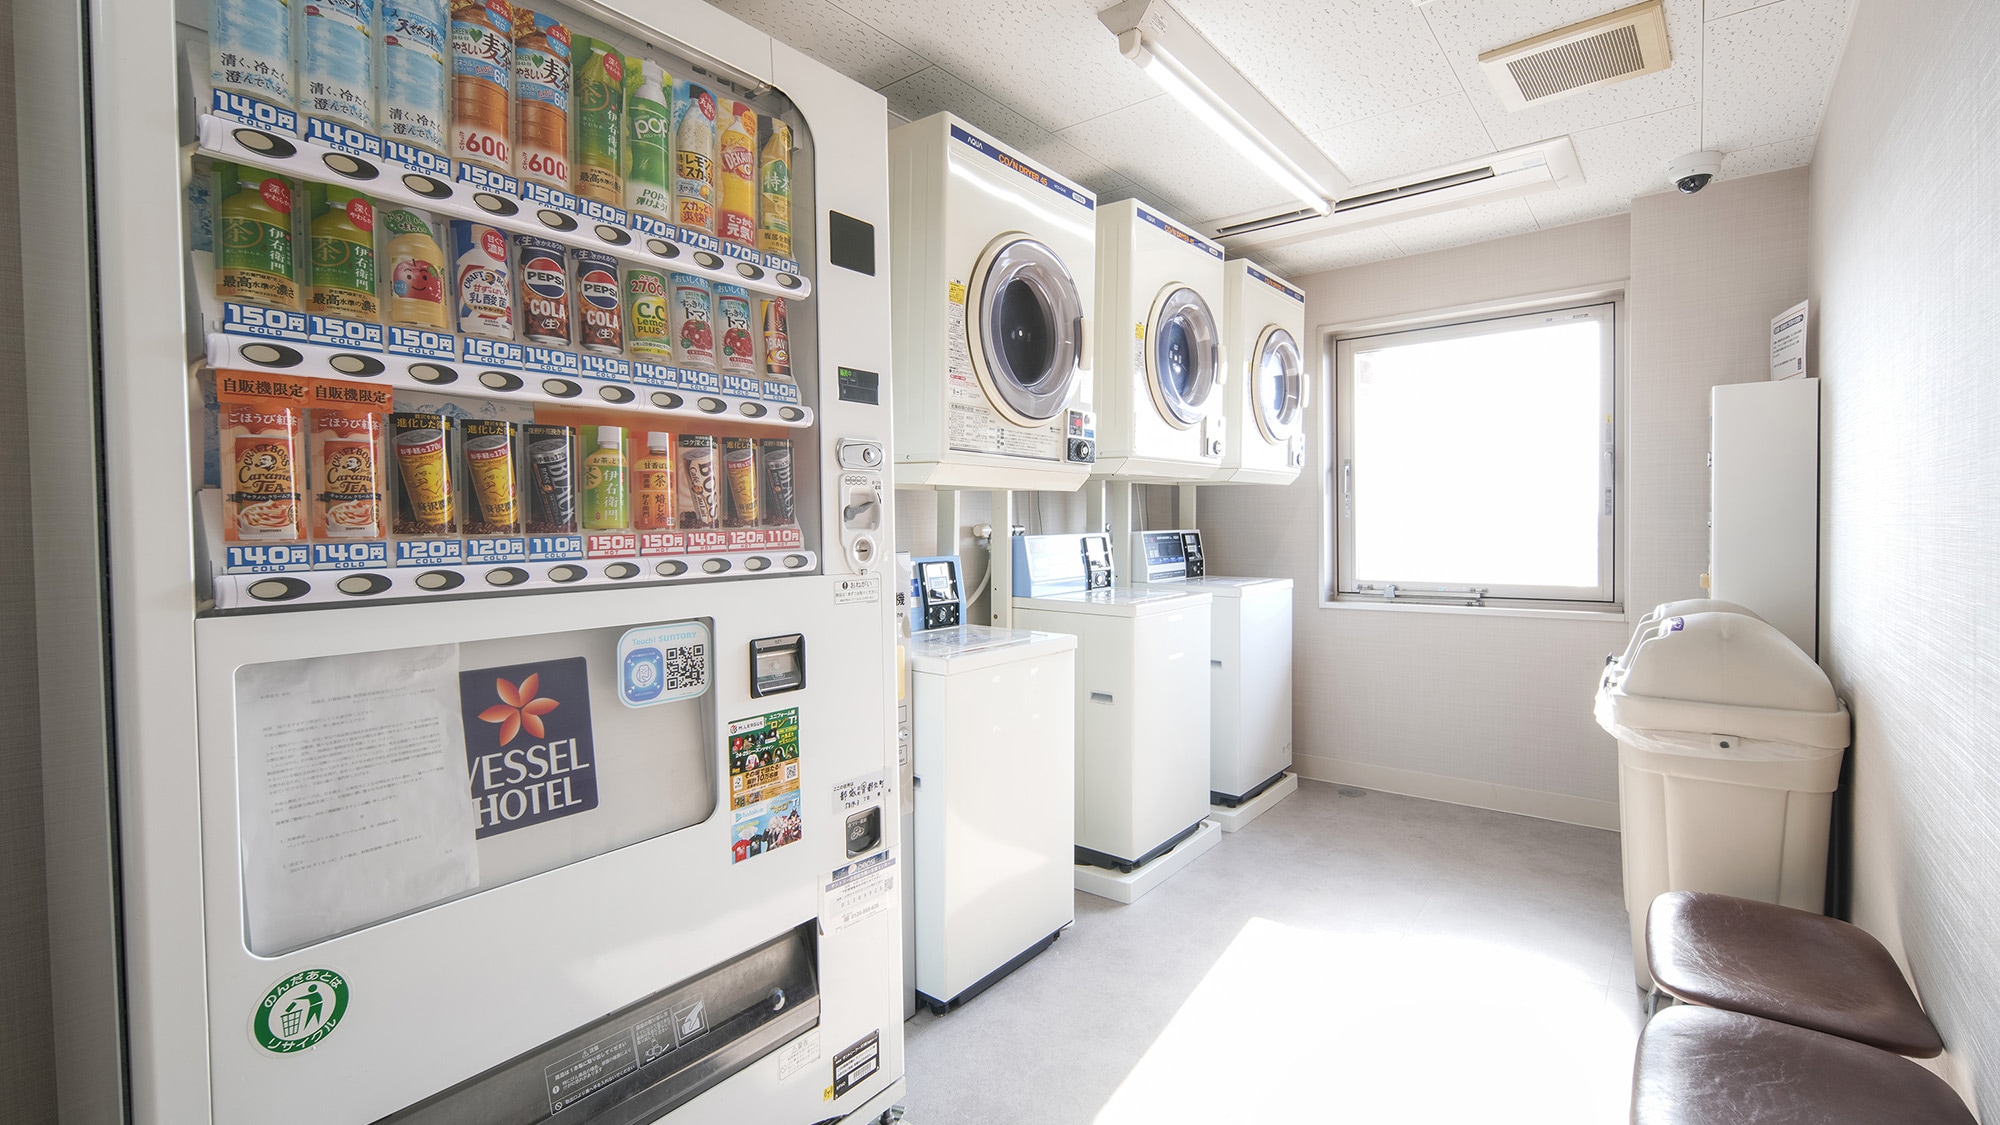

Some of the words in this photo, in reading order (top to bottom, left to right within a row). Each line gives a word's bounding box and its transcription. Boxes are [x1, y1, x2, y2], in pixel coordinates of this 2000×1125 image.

[394, 18, 441, 47] 天然水
[220, 52, 288, 85] 清く、冷たく、
[225, 69, 286, 99] 澄んでいる。
[215, 90, 294, 130] 140円
[237, 116, 272, 131] COLD
[311, 118, 381, 155] 140円
[330, 142, 360, 156] COLD
[387, 141, 449, 175] 140円
[403, 163, 431, 176] COLD
[461, 163, 517, 194] 150円
[1019, 164, 1040, 182] DRYER
[526, 182, 576, 211] 150円
[581, 199, 627, 226] 160円
[635, 214, 677, 239] 170円
[680, 228, 719, 252] 170円
[725, 242, 761, 264] 170円
[766, 254, 799, 276] 190円
[223, 275, 295, 299] 最高水準の濃さ
[312, 293, 377, 315] 最高水準の濃さ
[531, 300, 566, 320] COLA
[227, 303, 304, 332] 150円
[586, 310, 619, 330] COLA
[248, 326, 283, 336] COLD
[311, 316, 381, 342] 150円
[391, 326, 452, 351] 150円
[330, 337, 361, 346] COLD
[407, 347, 435, 356] COLD
[466, 337, 523, 360] 160円
[481, 357, 505, 365] COLD
[526, 347, 577, 368] 140円
[583, 355, 629, 375] 140円
[540, 364, 563, 372] COLD
[635, 363, 677, 380] 140円
[680, 369, 718, 387] 140円
[223, 378, 304, 398] 自販機限定
[724, 375, 759, 392] 140円
[764, 382, 798, 397] 140円
[315, 384, 388, 404] 自販機限定
[243, 444, 270, 466] CRAFT
[270, 443, 291, 467] BOSS
[252, 480, 286, 493] TEA
[654, 474, 667, 488] 茶
[603, 470, 619, 521] 伊右衛門
[533, 538, 581, 553] 110円
[591, 536, 636, 550] 150円
[643, 534, 683, 549] 150円
[689, 532, 726, 545] 140円
[731, 531, 764, 544] 120円
[769, 530, 799, 541] 110円
[230, 546, 307, 566] 140円
[315, 544, 384, 562] 140円
[400, 541, 460, 557] 120円
[470, 539, 523, 555] 120円
[472, 776, 582, 830] HOTEL
[264, 970, 343, 1008] のんだあとは
[267, 1018, 337, 1053] リサイクル
